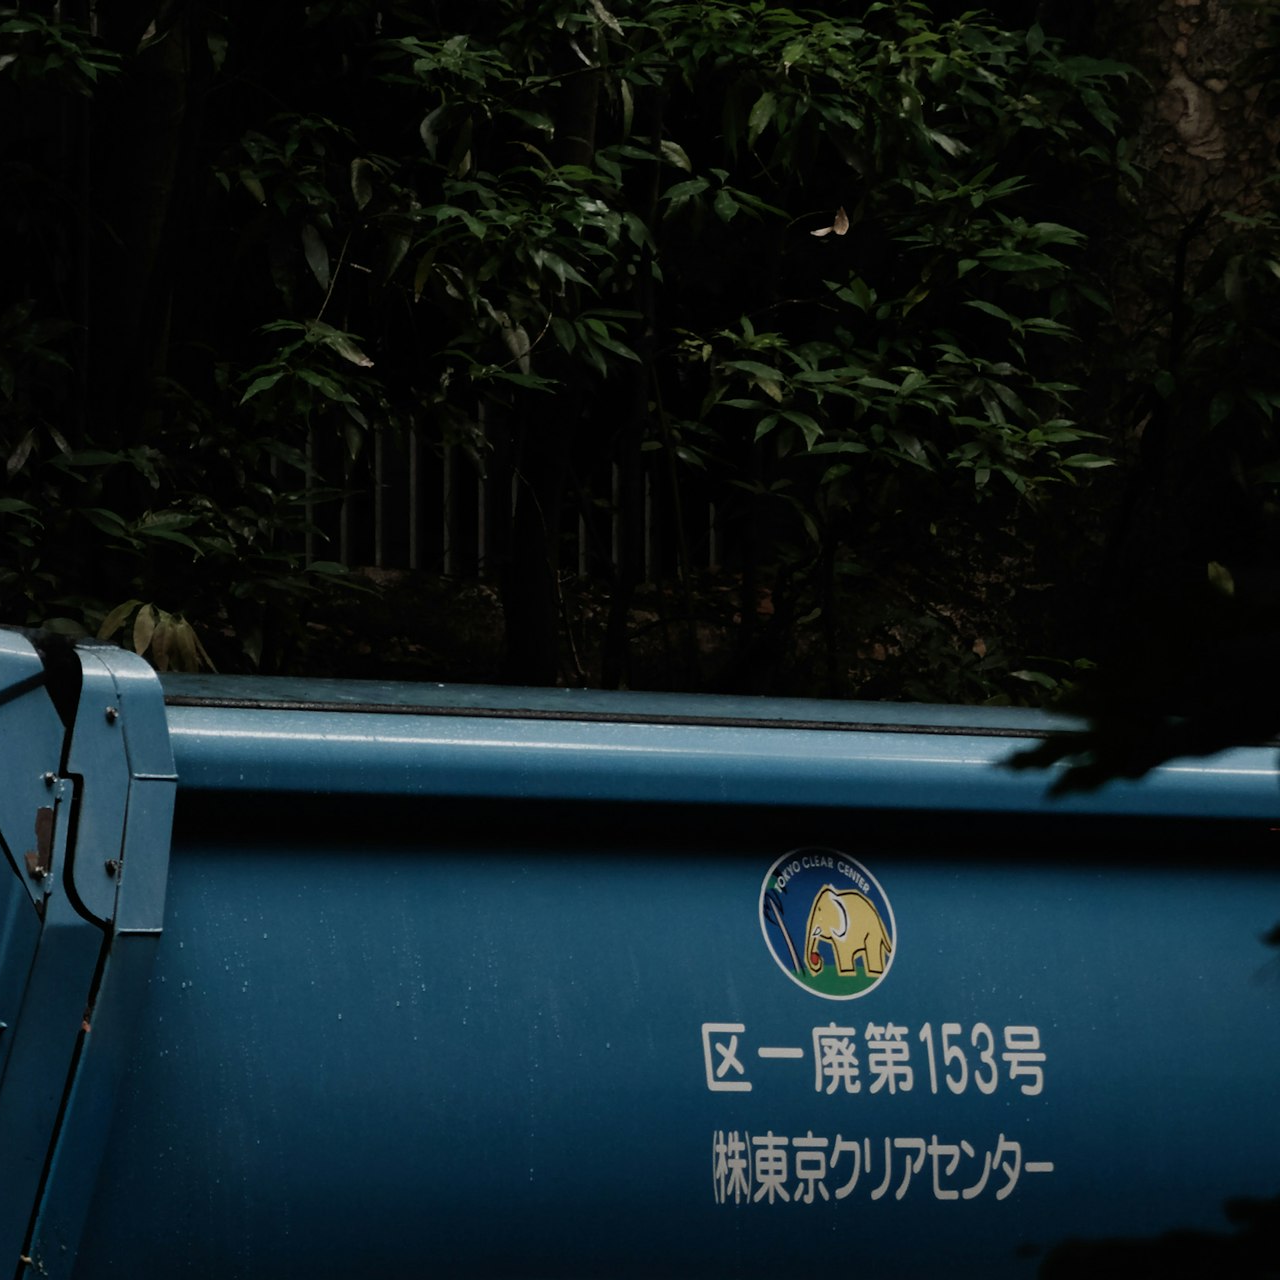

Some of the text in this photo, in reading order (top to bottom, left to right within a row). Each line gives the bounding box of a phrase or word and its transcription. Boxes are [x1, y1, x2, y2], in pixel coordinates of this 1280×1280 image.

[774, 856, 870, 894] TOKYO CLEAR CENTER
[701, 1022, 1047, 1096] 区一廃第153号
[713, 1130, 1054, 1205] (株)東京クリアセンター
